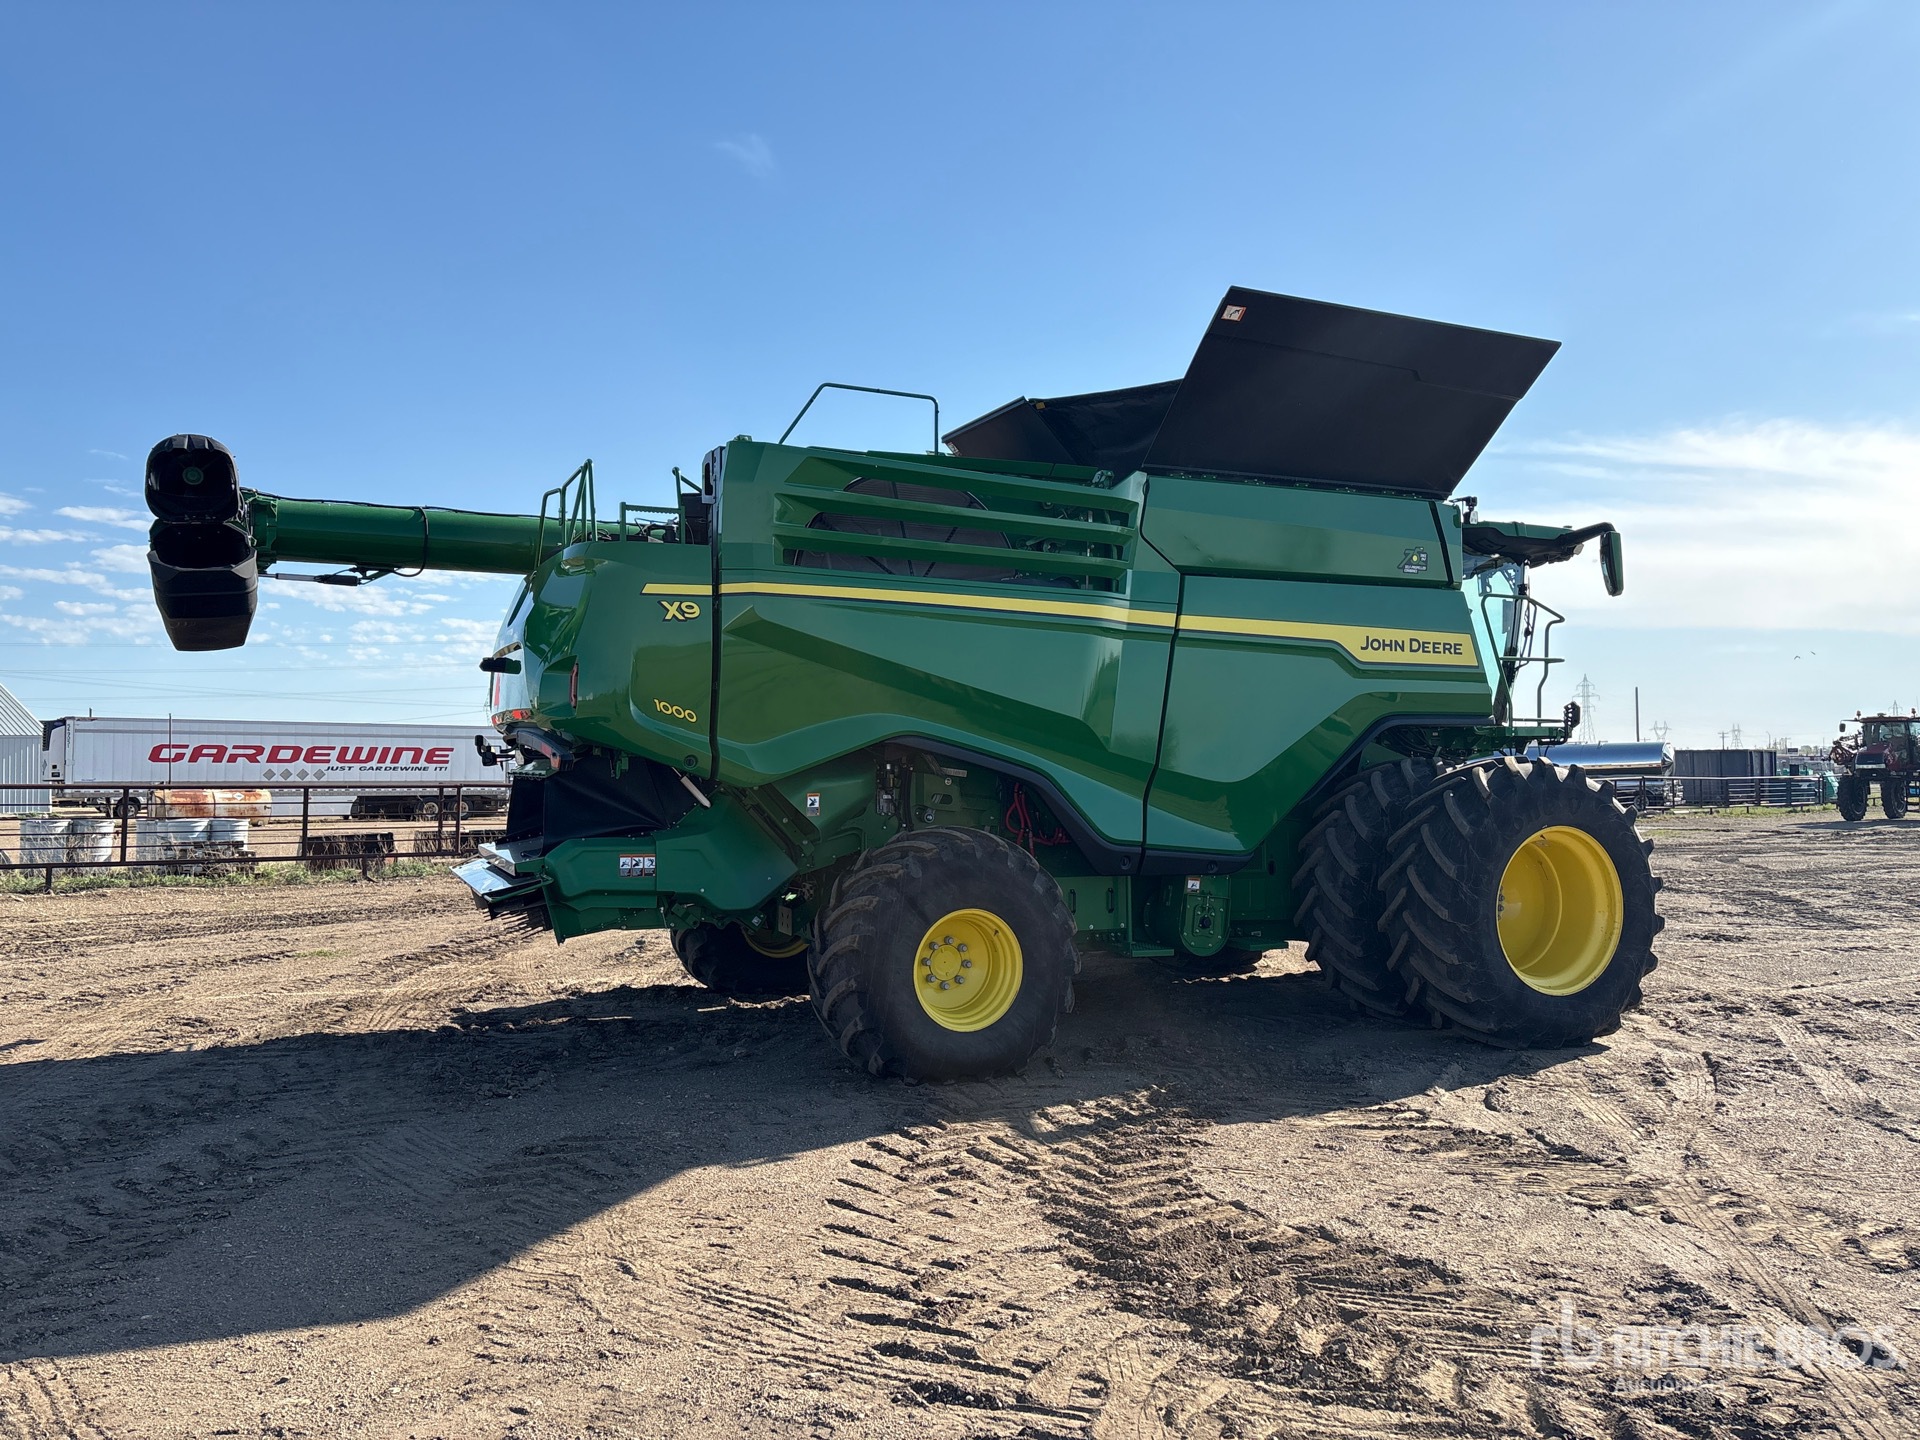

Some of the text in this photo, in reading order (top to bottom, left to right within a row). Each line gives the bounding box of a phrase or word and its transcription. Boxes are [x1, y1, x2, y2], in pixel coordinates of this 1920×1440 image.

[658, 600, 701, 621] X9
[1360, 635, 1463, 655] JOHN DEERE
[653, 698, 698, 723] 1000
[148, 743, 454, 765] GARDEWINE
